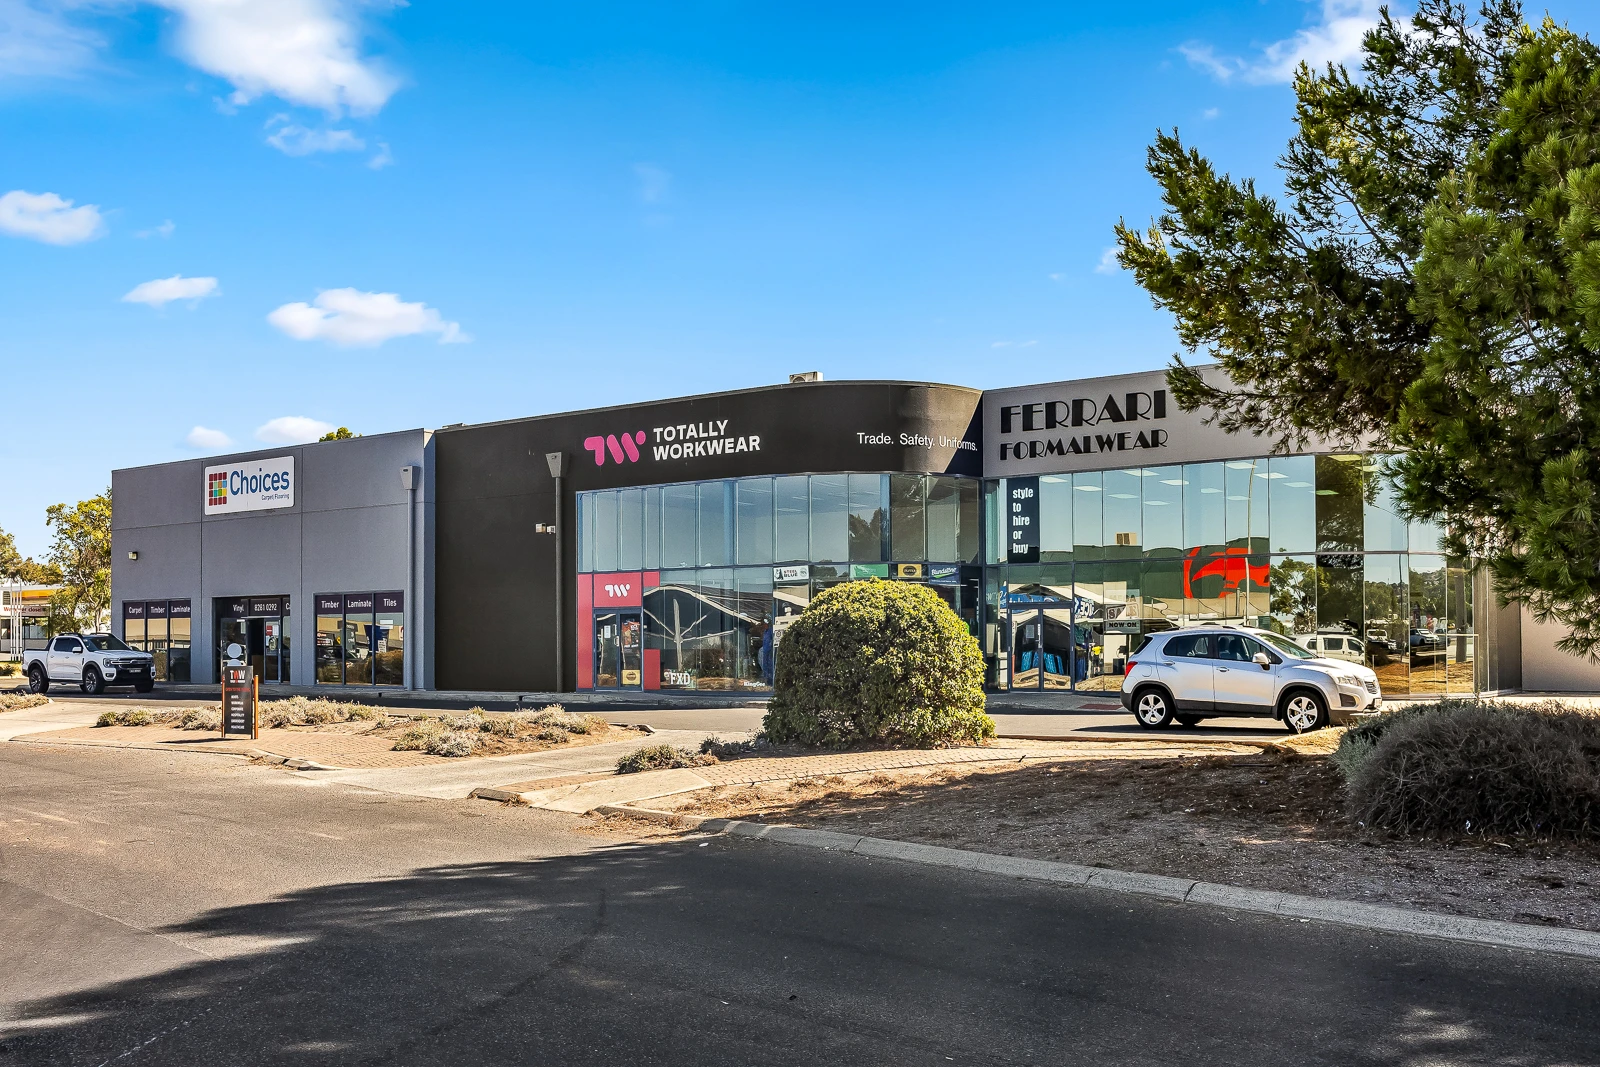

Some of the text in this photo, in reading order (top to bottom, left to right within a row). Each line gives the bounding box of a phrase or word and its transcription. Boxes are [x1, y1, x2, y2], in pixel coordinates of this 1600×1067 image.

[1000, 390, 1166, 434] FERRARI
[653, 419, 729, 443] TOTALLY
[857, 432, 978, 451] Trade. Safety. Uniforms.
[1000, 429, 1168, 460] FORMALWEAR
[652, 435, 761, 461] WORKWEAR
[230, 467, 290, 496] Choices
[1012, 487, 1034, 499] style
[1012, 502, 1022, 512] to
[1012, 515, 1030, 526] hire
[1012, 530, 1023, 540] or
[1012, 542, 1029, 554] buy
[321, 600, 340, 609] Timber
[347, 599, 372, 608] Laminate
[383, 598, 397, 607] Tiles
[128, 606, 143, 615] Carpet
[150, 606, 166, 614] Timber
[170, 605, 191, 613] Laminate
[232, 604, 245, 613] Vinyl
[670, 672, 691, 685] FXD
